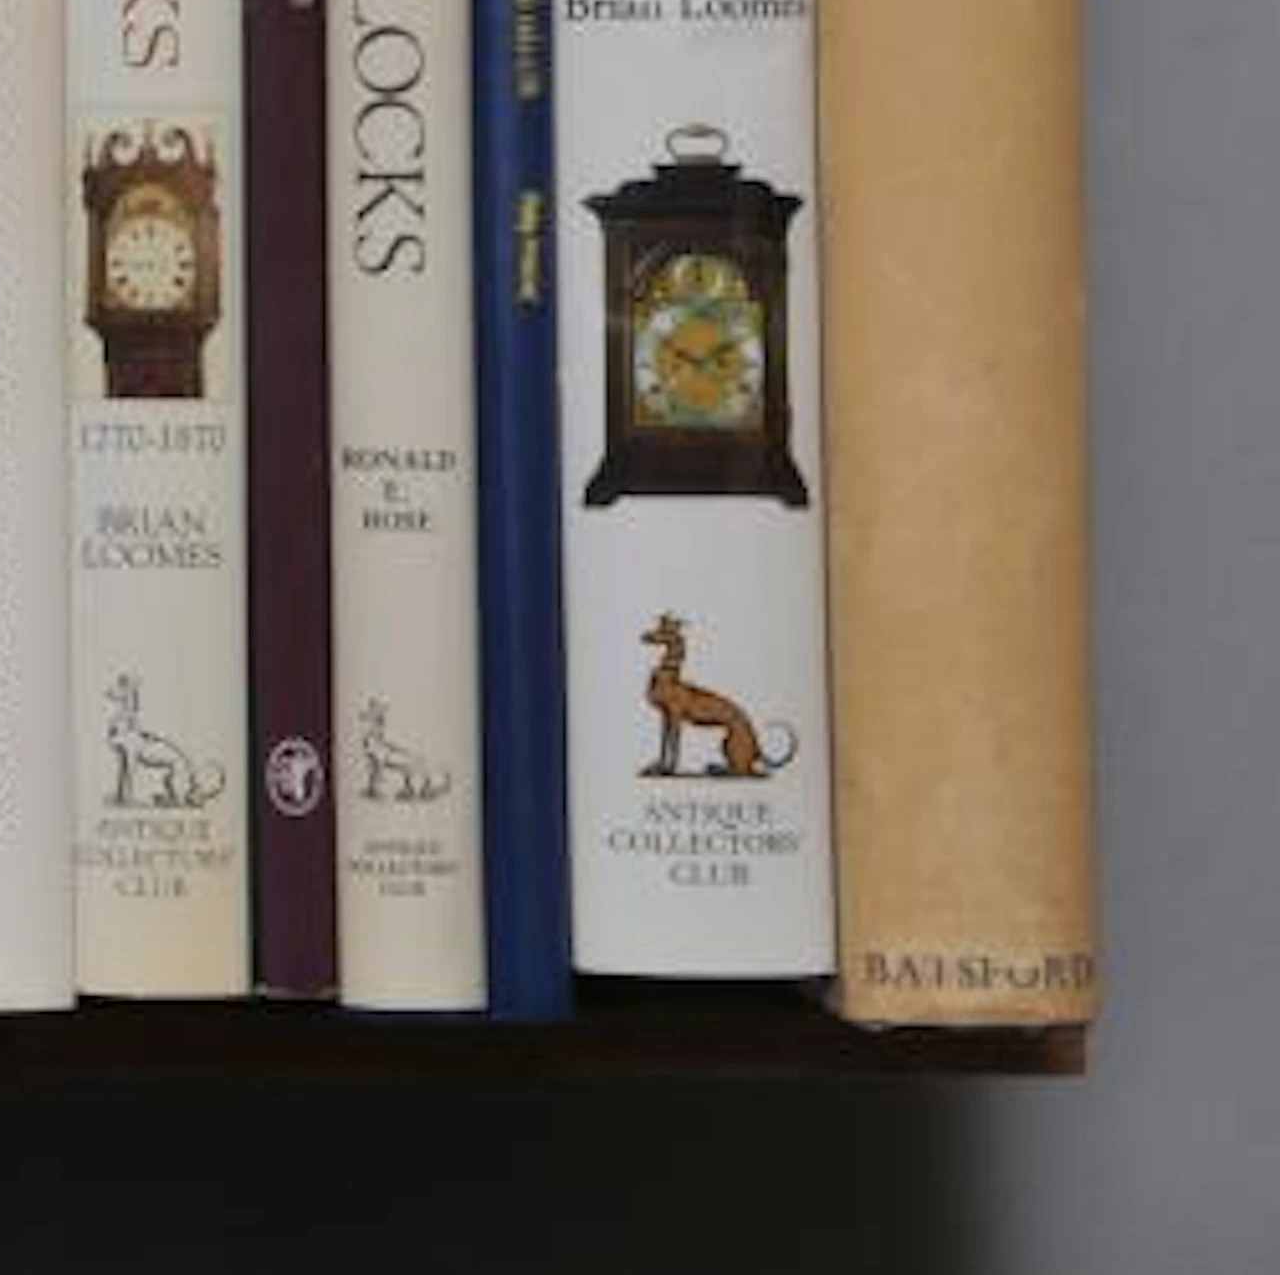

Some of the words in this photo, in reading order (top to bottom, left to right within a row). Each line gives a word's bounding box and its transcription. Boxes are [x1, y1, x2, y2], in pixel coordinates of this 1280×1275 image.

[341, 446, 458, 472] RONALD
[95, 504, 209, 538] BRIAN
[81, 537, 225, 570] LOOMES
[644, 801, 771, 832] ANTIQUE
[669, 861, 750, 888] CLUB
